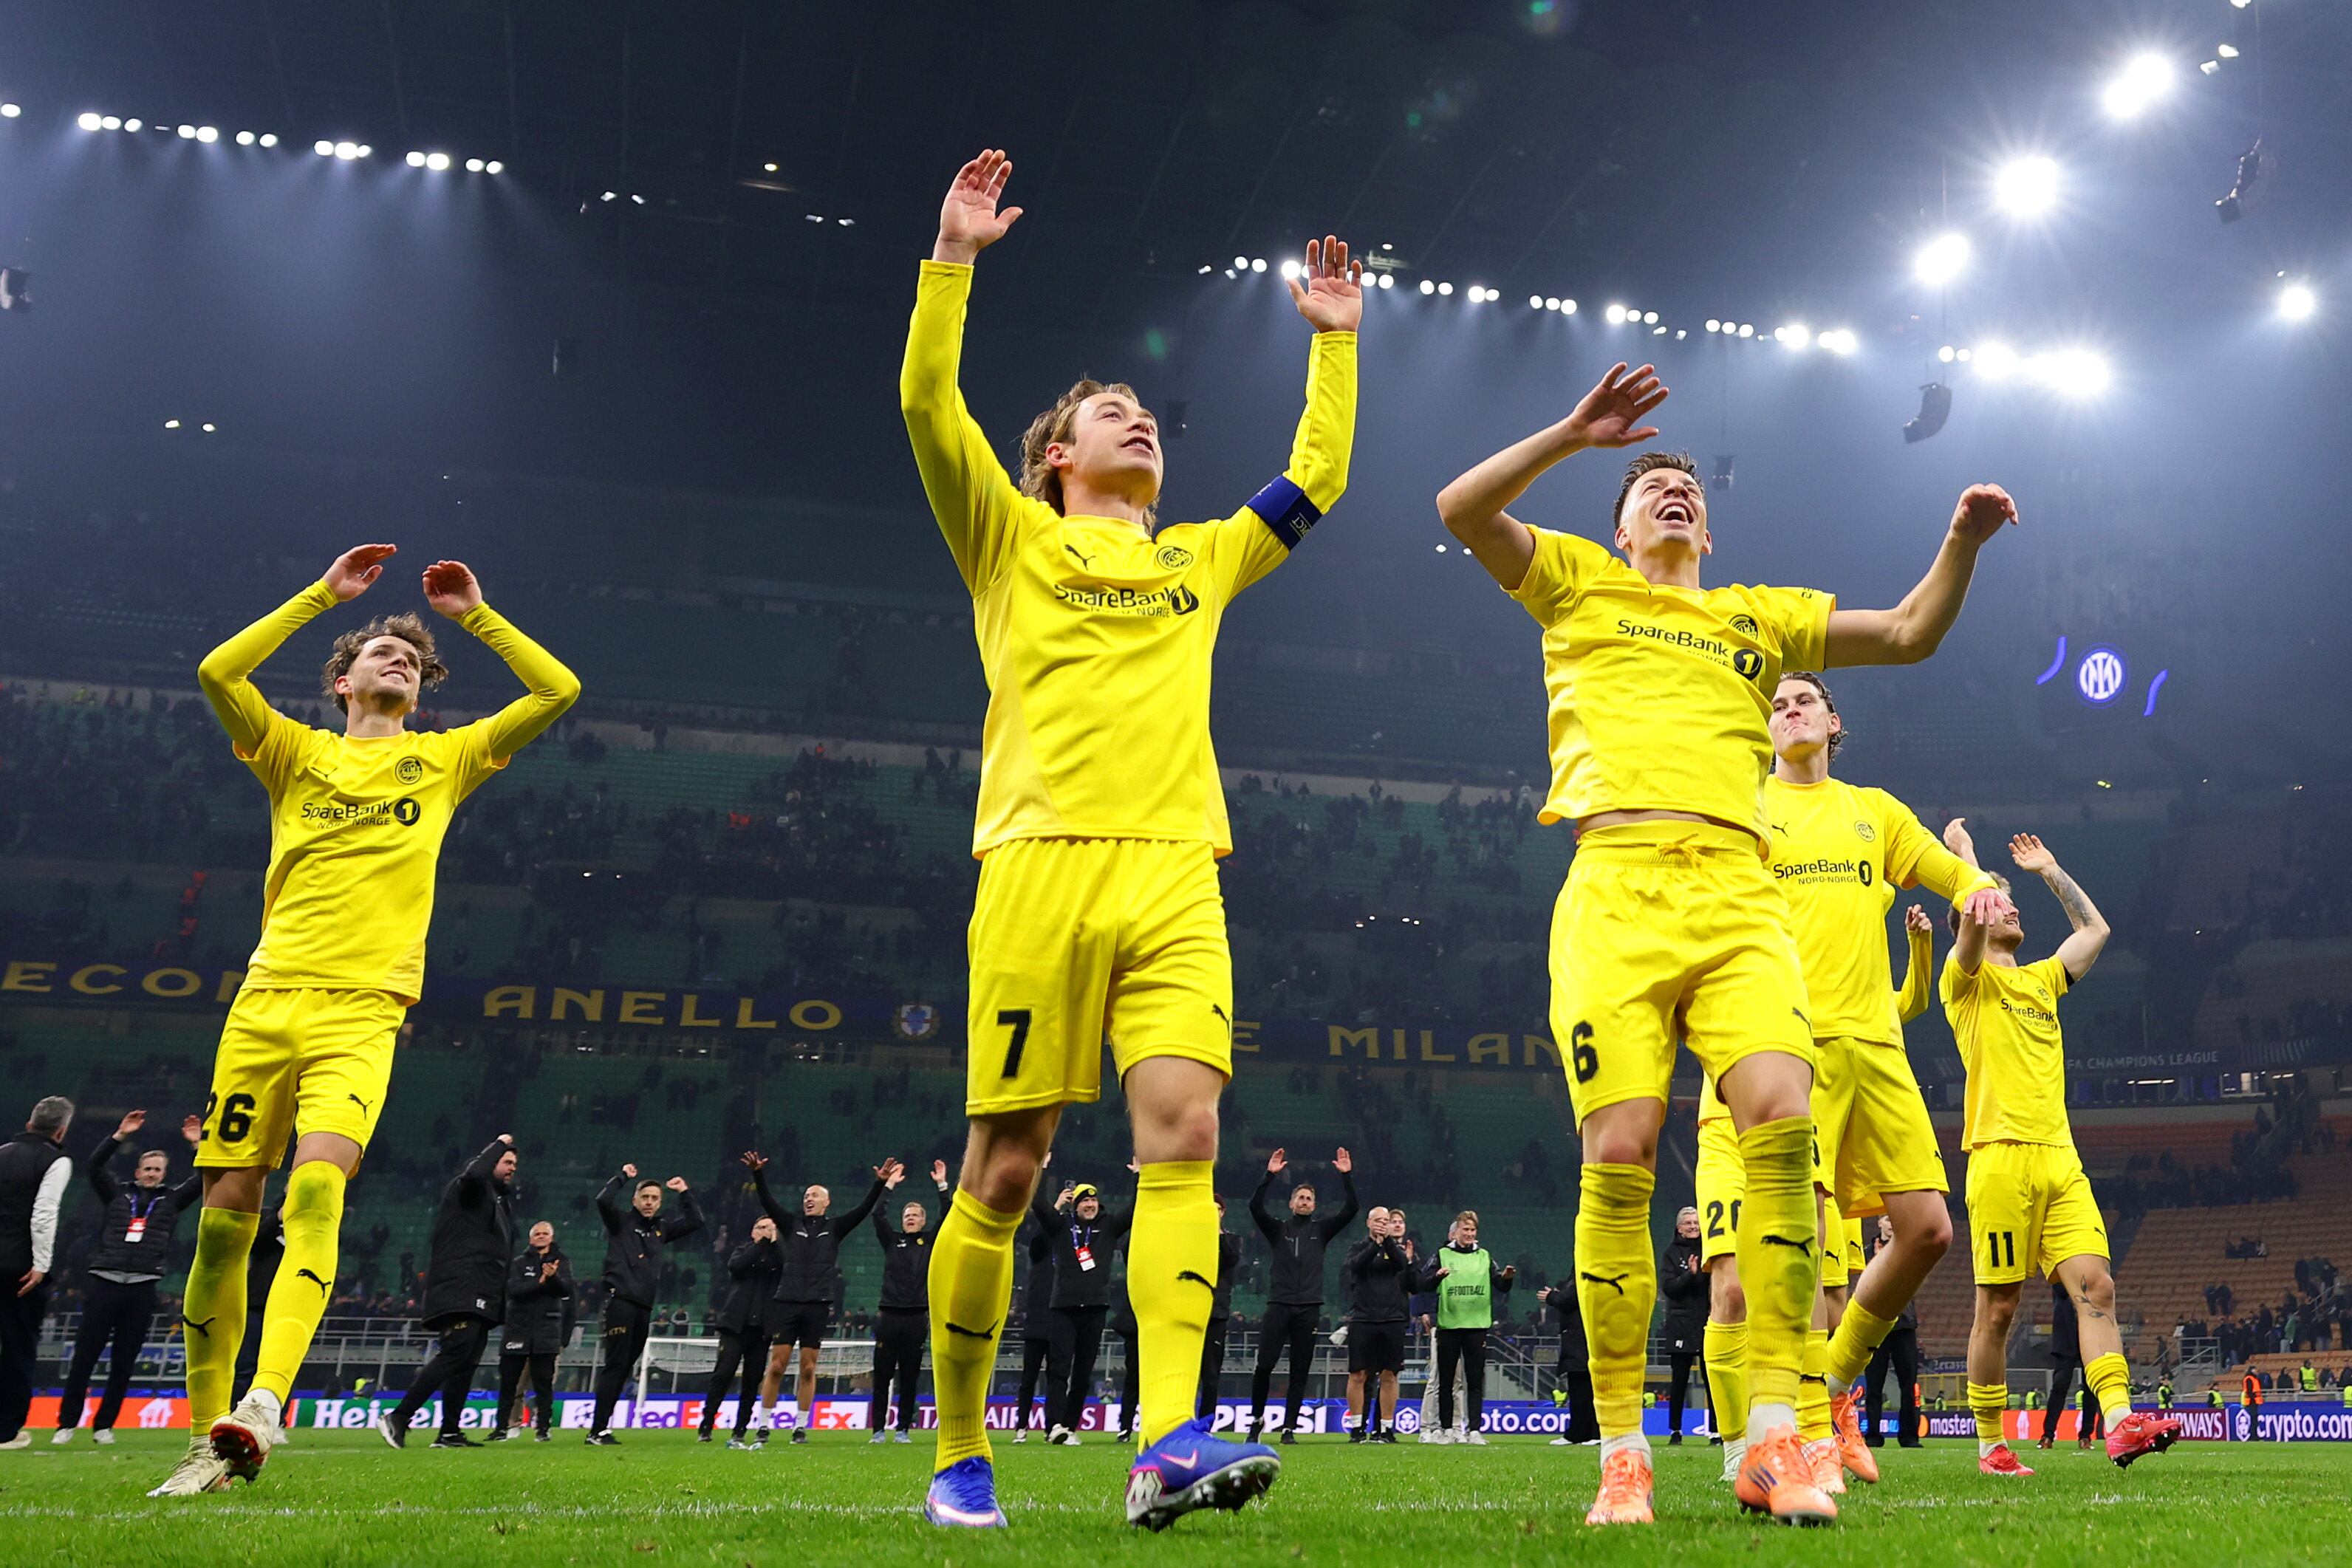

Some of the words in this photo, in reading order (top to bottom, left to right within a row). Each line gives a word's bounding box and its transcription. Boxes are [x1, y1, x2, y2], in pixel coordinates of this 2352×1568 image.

[1054, 583, 1177, 608] SpareBank
[1616, 620, 1729, 657] SpareBank
[301, 801, 393, 821] SpareBank
[1773, 859, 1856, 880] SpareBank
[483, 986, 843, 1030] ANELLO
[997, 1010, 1032, 1079] 7
[1571, 1020, 1599, 1085] 6
[2087, 1055, 2166, 1070] CHAMPIONS
[2170, 1050, 2219, 1066] LEAGUE
[1988, 1231, 2014, 1267] 11
[1210, 1406, 1327, 1434] PEPSI
